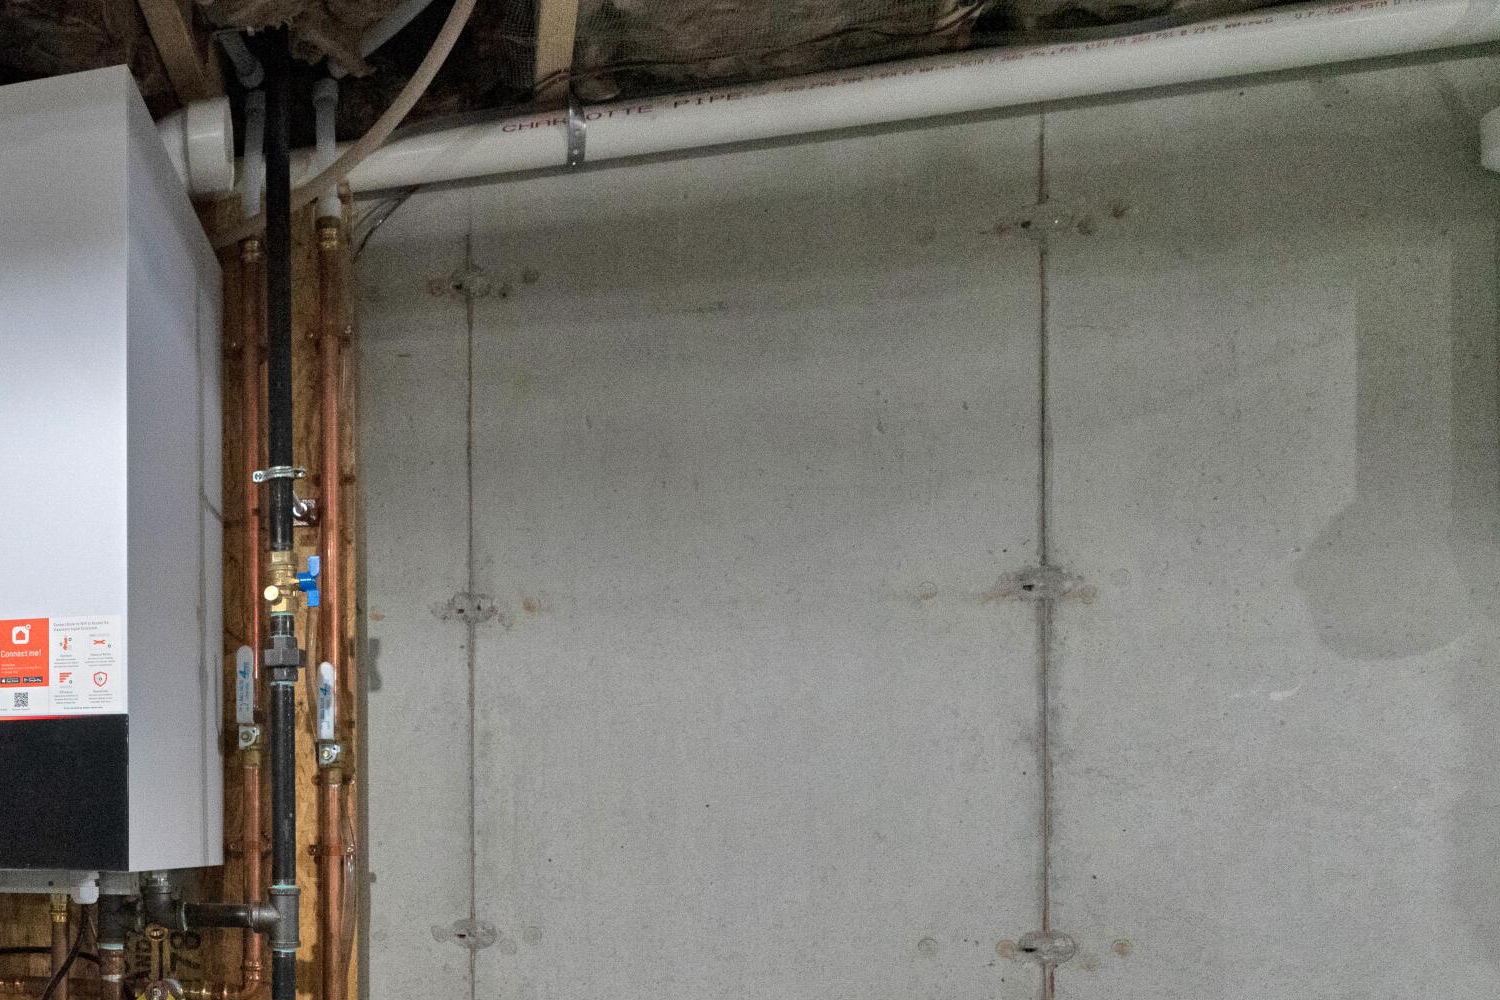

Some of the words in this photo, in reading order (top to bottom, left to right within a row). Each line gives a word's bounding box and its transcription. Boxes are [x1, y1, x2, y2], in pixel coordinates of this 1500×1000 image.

[501, 105, 653, 133] CHAROTTE
[673, 94, 742, 109] PIPE
[0, 650, 28, 659] Connect
[28, 648, 42, 658] me!
